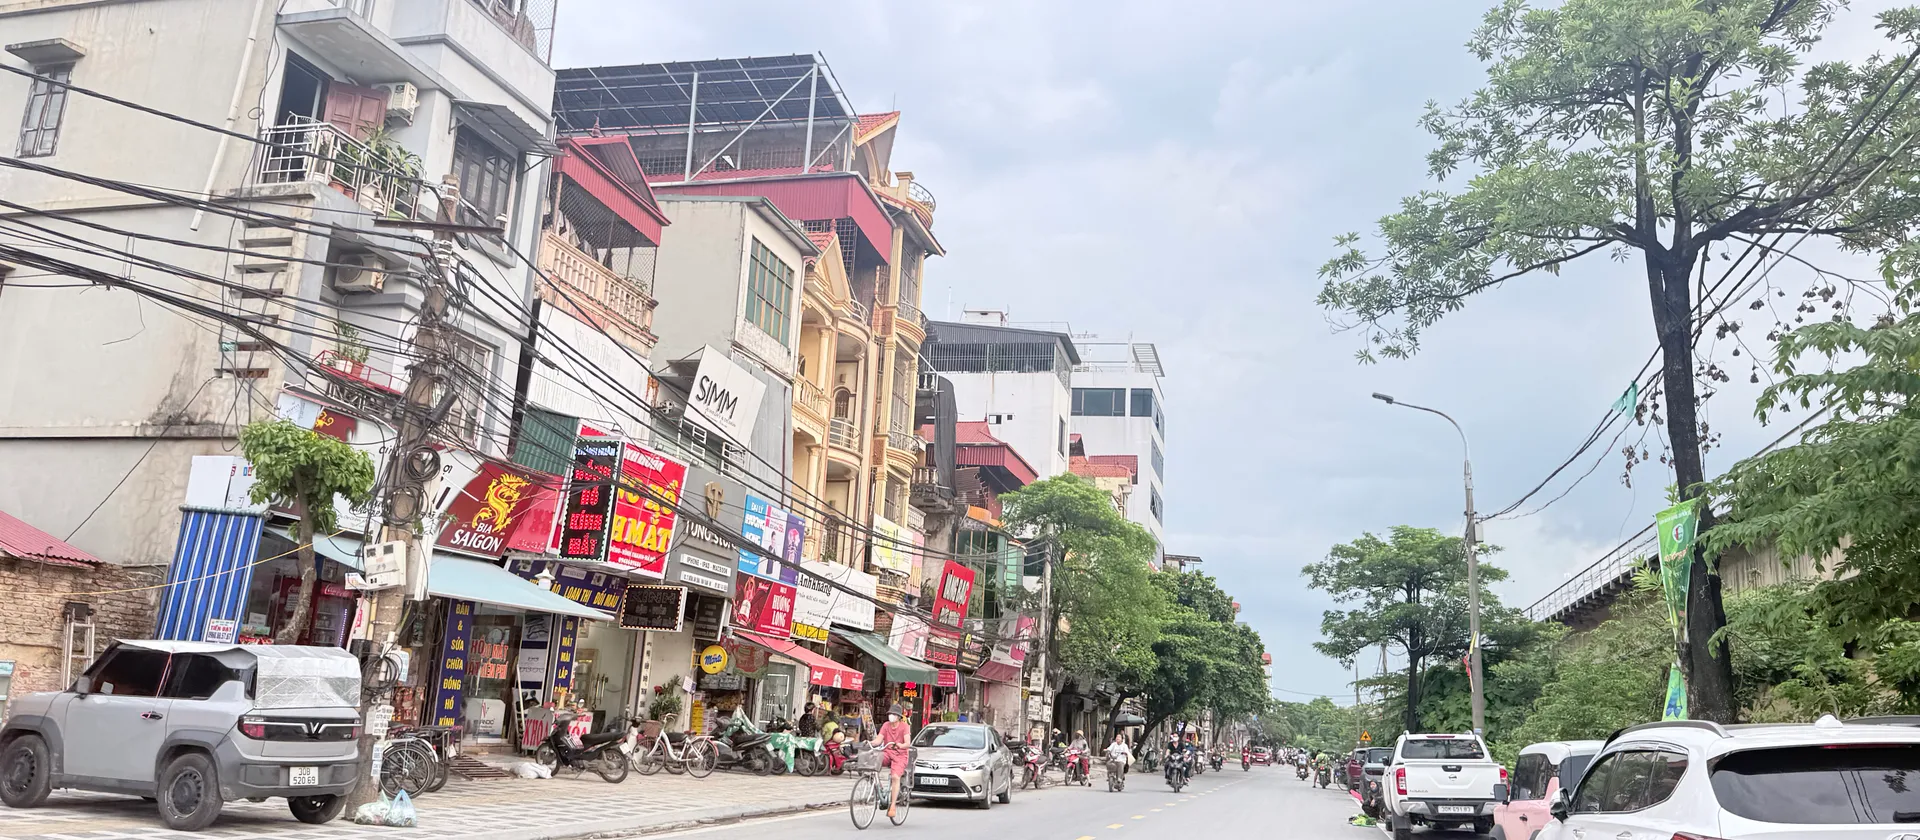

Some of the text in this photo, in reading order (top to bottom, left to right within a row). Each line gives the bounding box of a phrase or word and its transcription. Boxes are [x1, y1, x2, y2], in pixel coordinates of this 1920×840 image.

[696, 375, 738, 420] SIMM
[475, 522, 493, 534] BIA
[450, 528, 504, 553] SAIGON
[456, 603, 469, 616] BÁN
[457, 620, 463, 631] &
[298, 767, 311, 776] 30B
